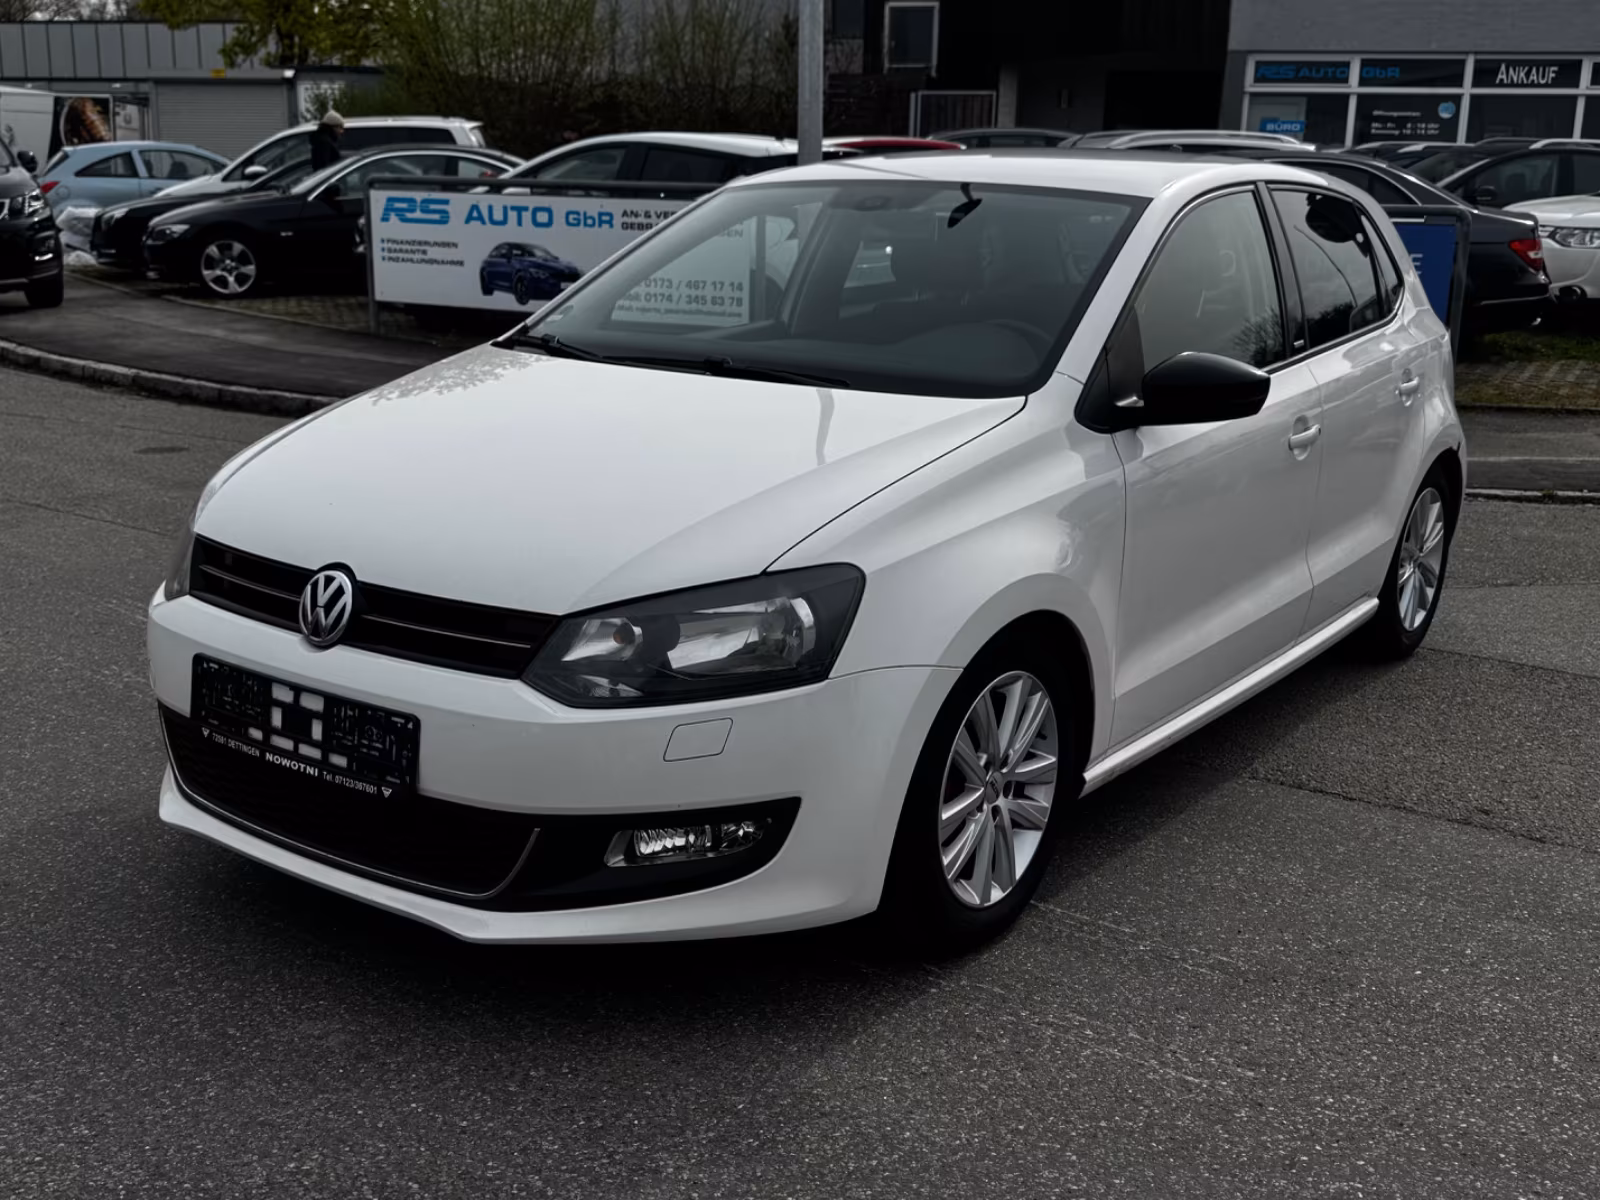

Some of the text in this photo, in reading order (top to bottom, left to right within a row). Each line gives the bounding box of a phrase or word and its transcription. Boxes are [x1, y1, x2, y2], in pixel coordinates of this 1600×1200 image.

[1255, 64, 1401, 79] RS AUTO GbR
[1266, 121, 1301, 131] BÜRO
[380, 196, 615, 229] RS AUTO GbR
[621, 222, 658, 231] GEBR
[386, 238, 458, 249] FINANZIERUNGEN
[387, 247, 428, 256] GARANTIE
[711, 281, 726, 292] 17
[729, 282, 743, 293] 14
[644, 292, 673, 304] 0174
[685, 295, 707, 306] 345
[227, 738, 260, 757] DETTINGEN
[265, 752, 319, 777] NOWOTNI
